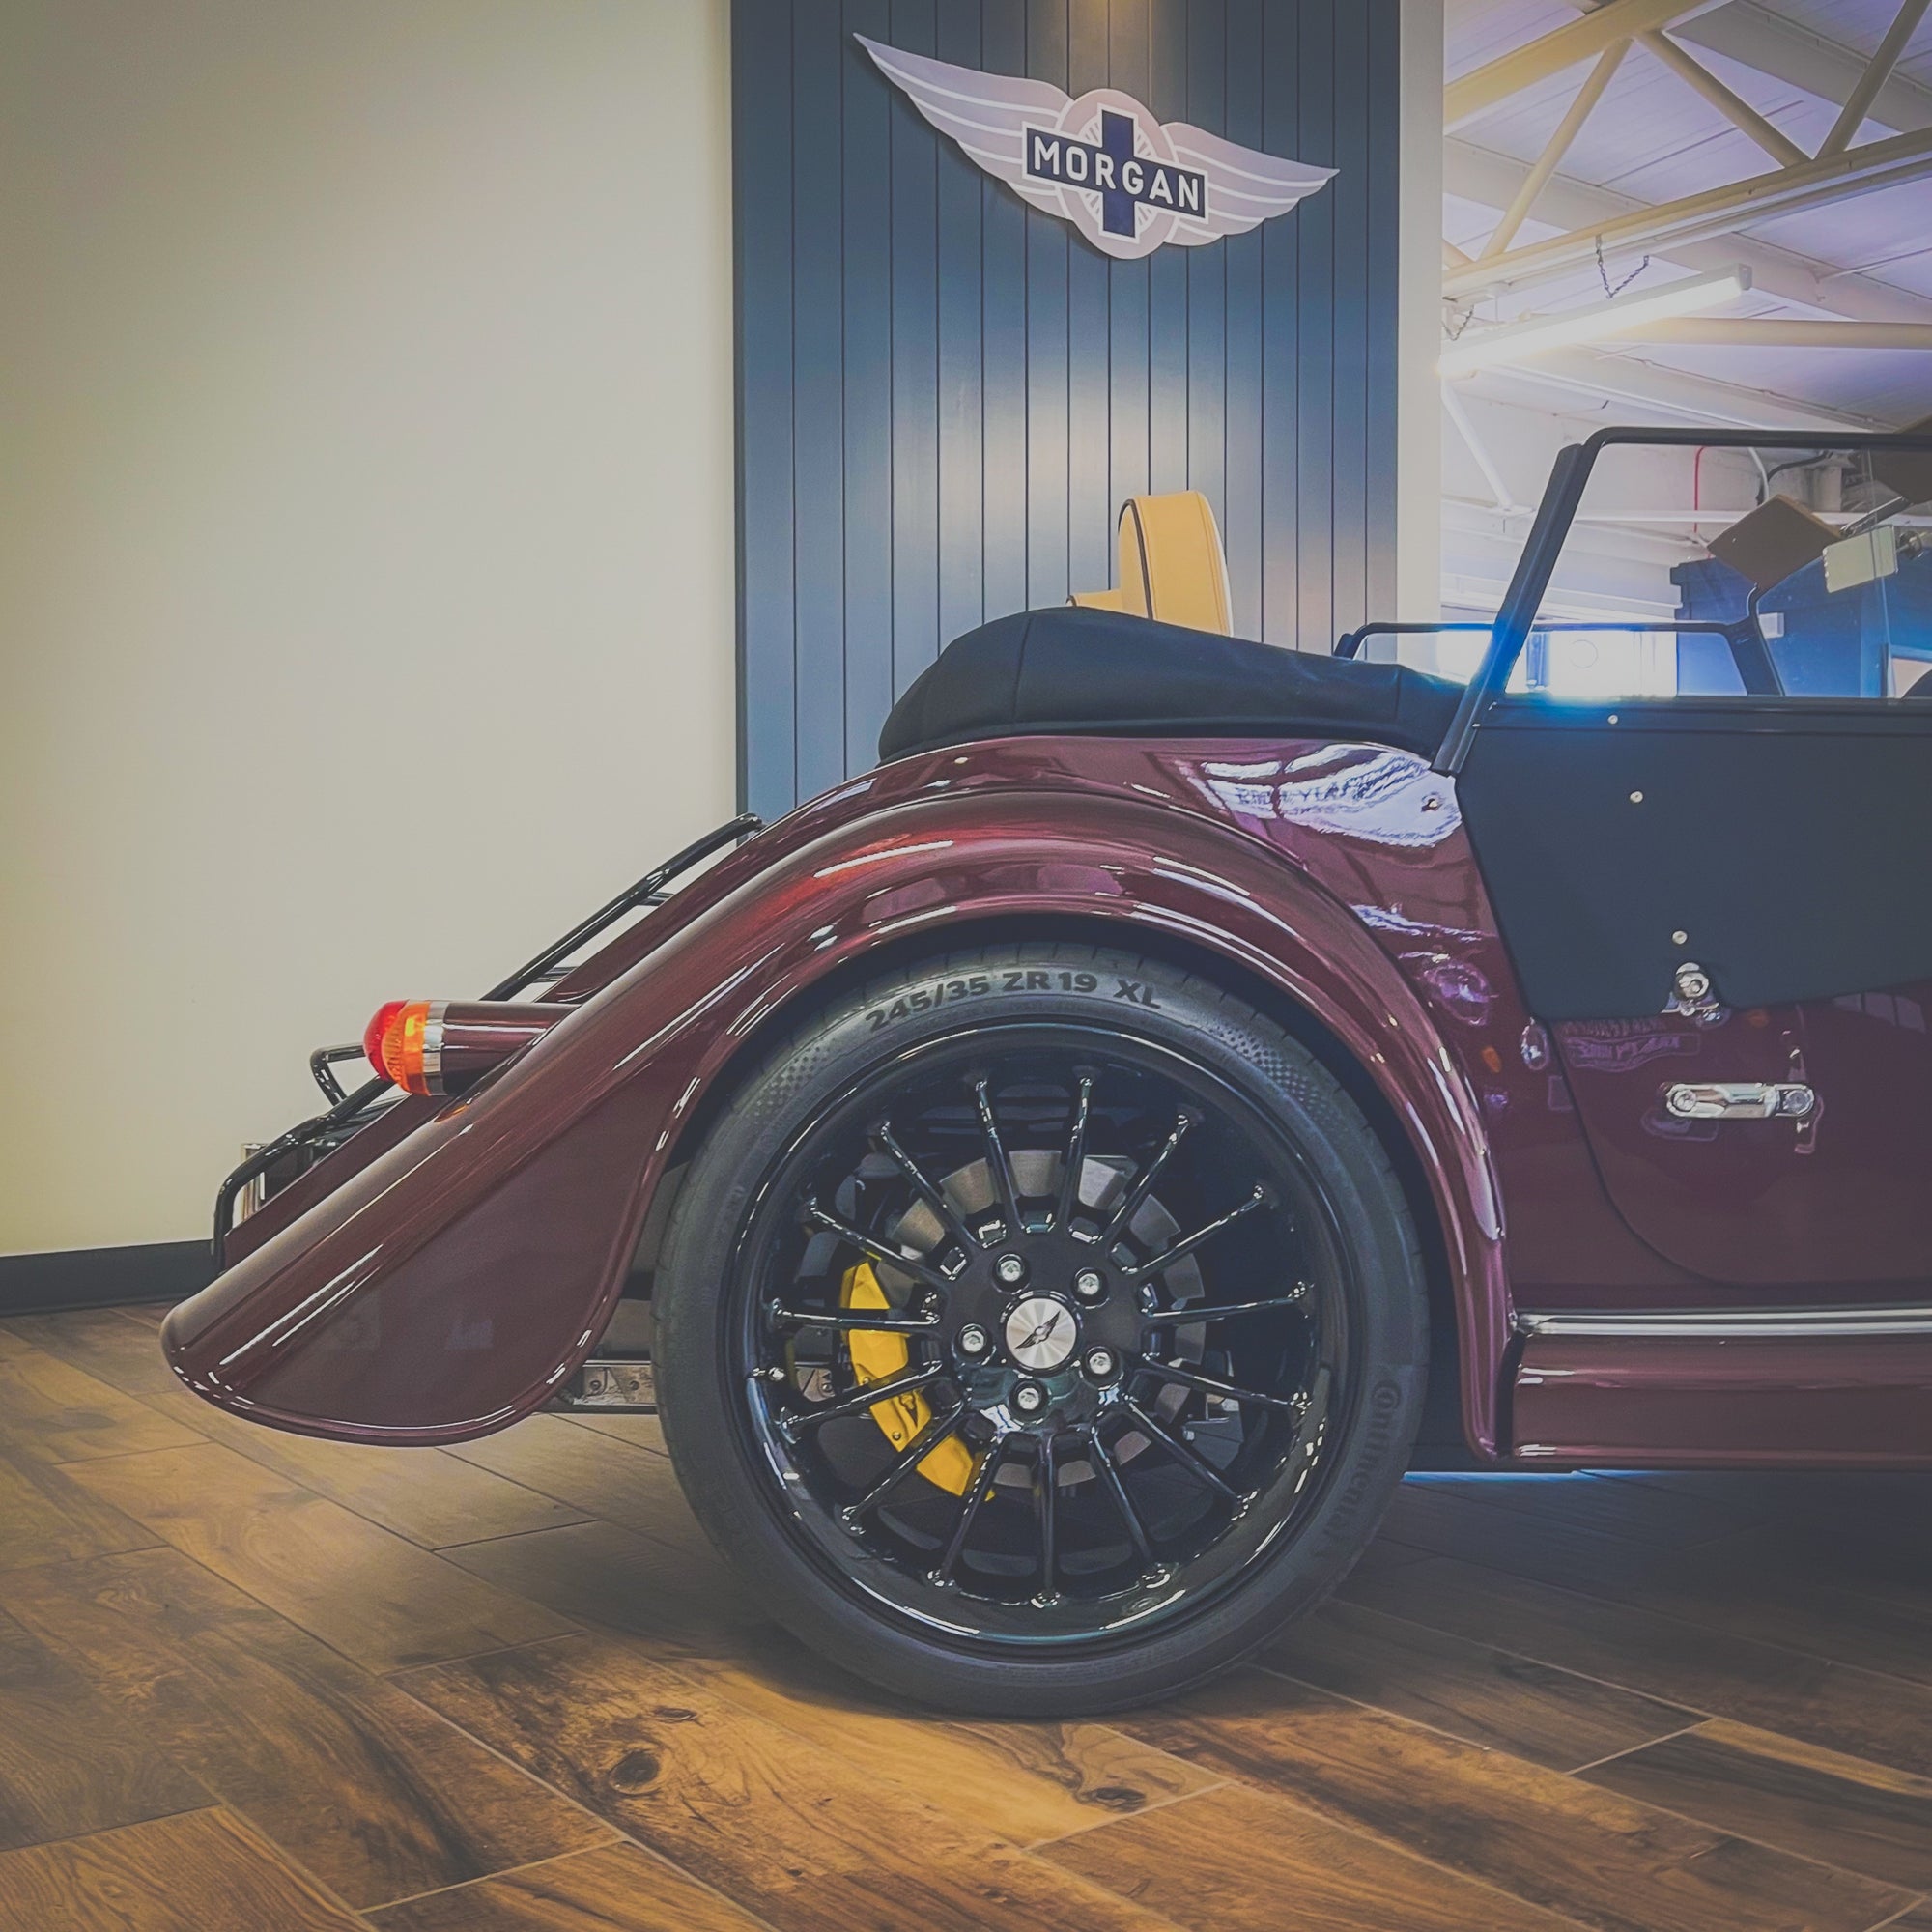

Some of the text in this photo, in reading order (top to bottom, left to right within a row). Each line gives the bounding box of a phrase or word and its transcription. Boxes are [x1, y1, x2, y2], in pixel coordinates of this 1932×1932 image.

[1034, 135, 1199, 211] MORGAN
[865, 975, 991, 1033] 245/35
[1113, 979, 1161, 1009] XL
